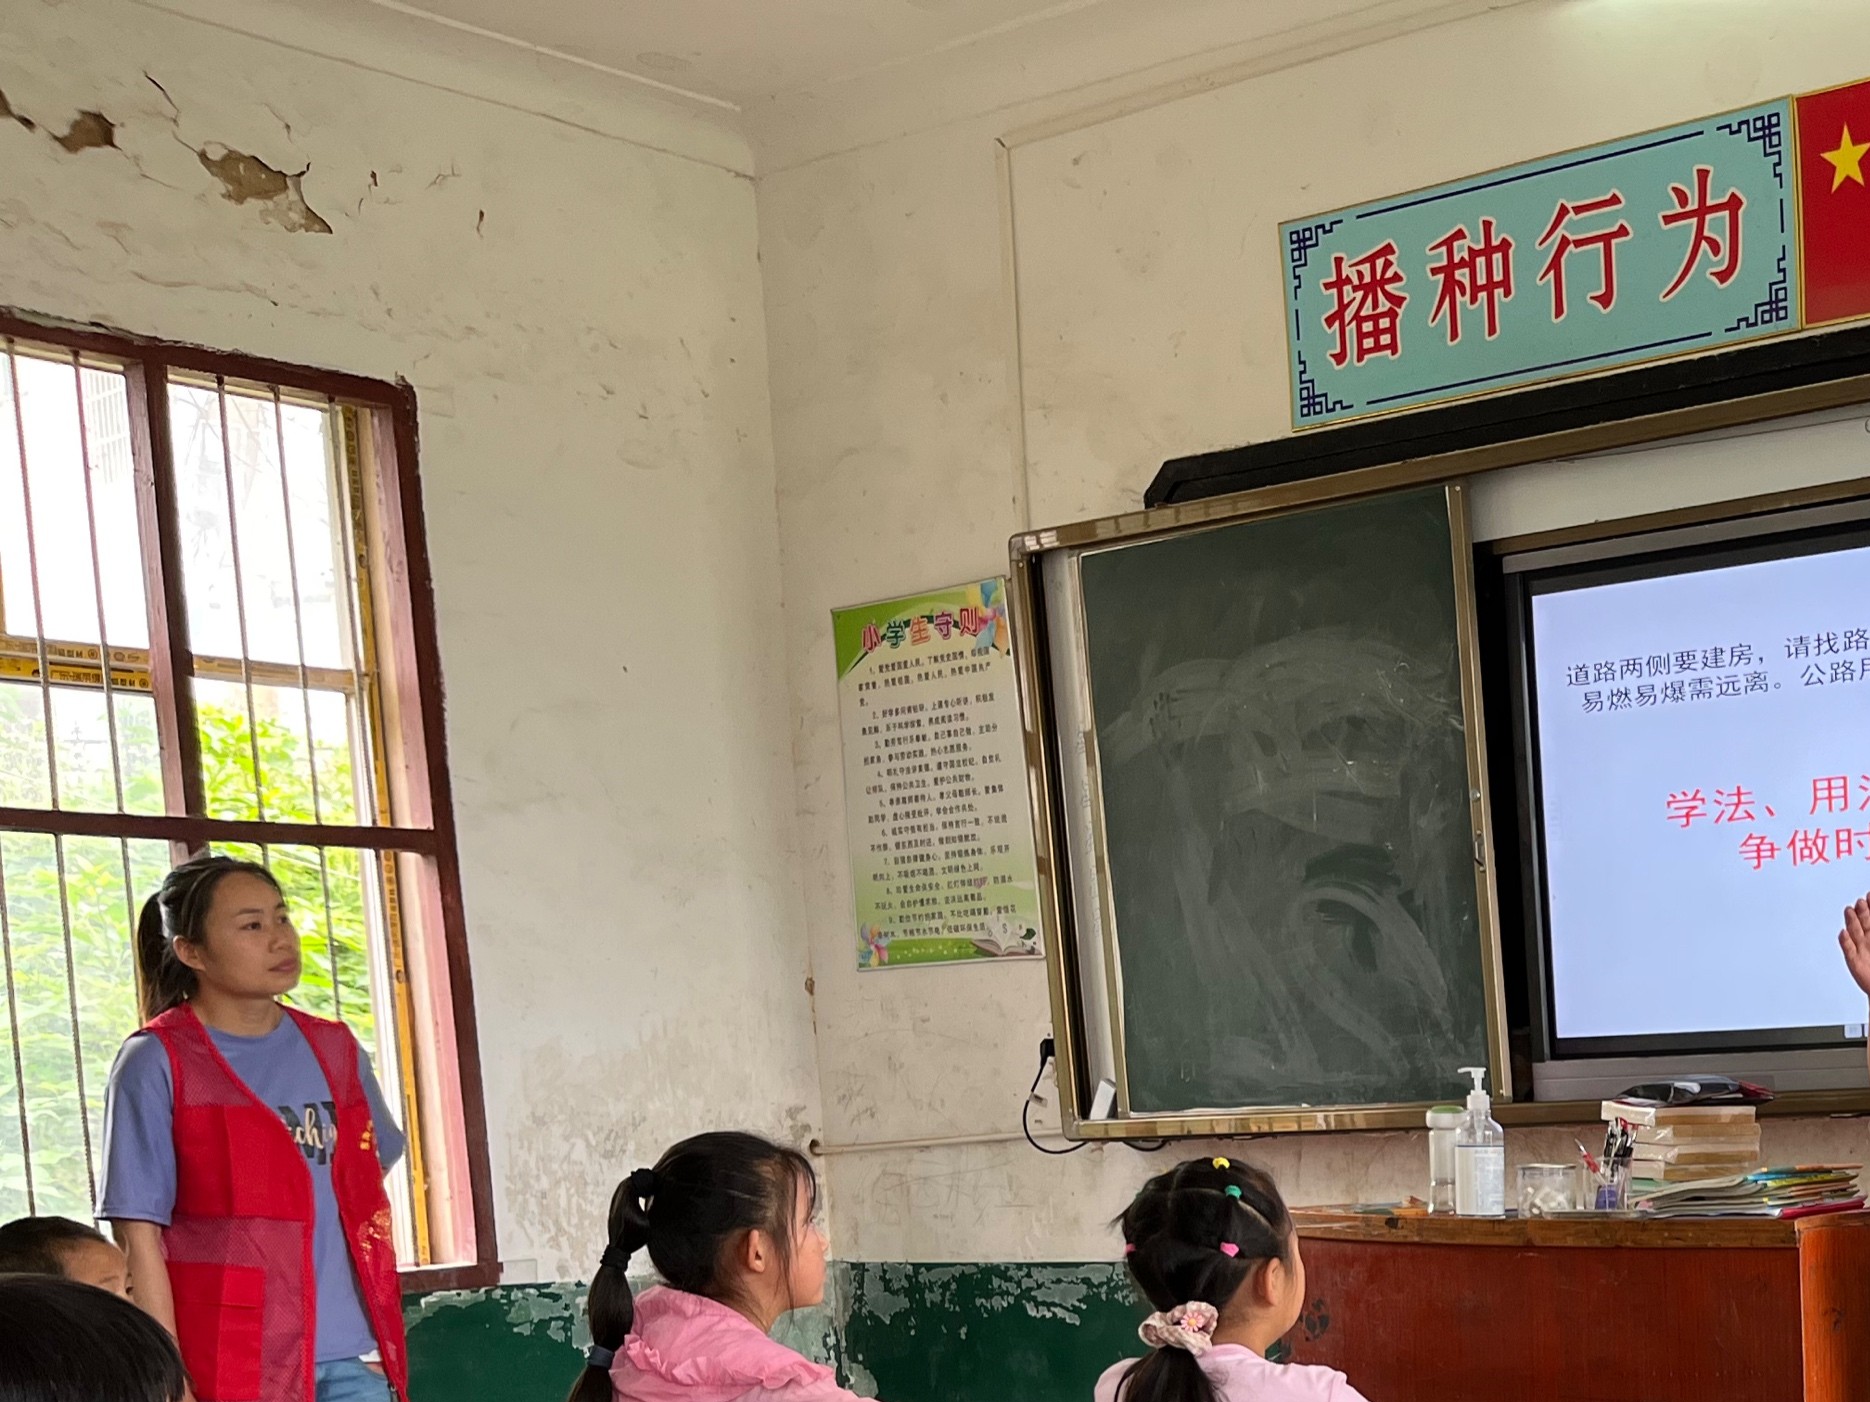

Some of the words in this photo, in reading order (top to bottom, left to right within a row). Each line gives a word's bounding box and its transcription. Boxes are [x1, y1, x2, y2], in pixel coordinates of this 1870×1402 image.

[1322, 166, 1746, 367] 播种行为
[862, 607, 980, 653] 小学生守则
